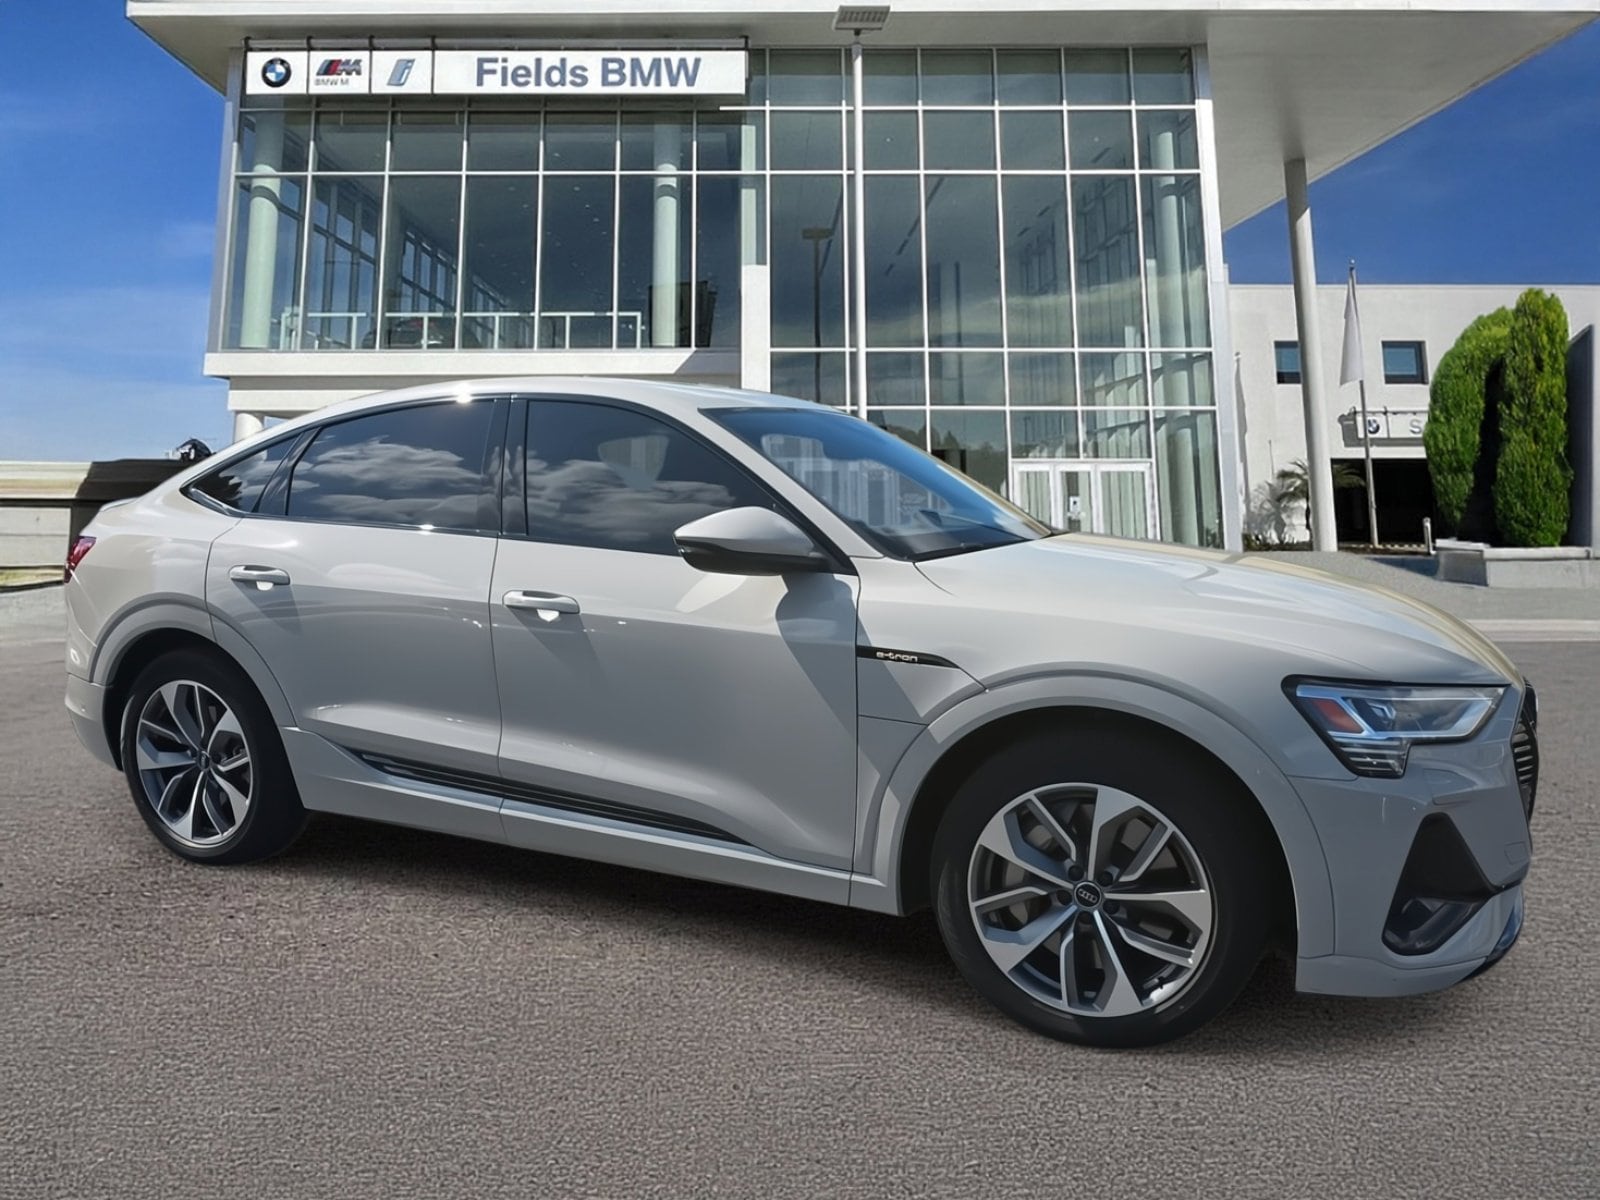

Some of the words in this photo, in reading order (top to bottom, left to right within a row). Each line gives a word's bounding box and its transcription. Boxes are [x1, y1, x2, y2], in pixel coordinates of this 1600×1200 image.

[476, 57, 589, 88] Fields
[601, 57, 701, 88] BMW
[876, 651, 918, 663] e-tron
